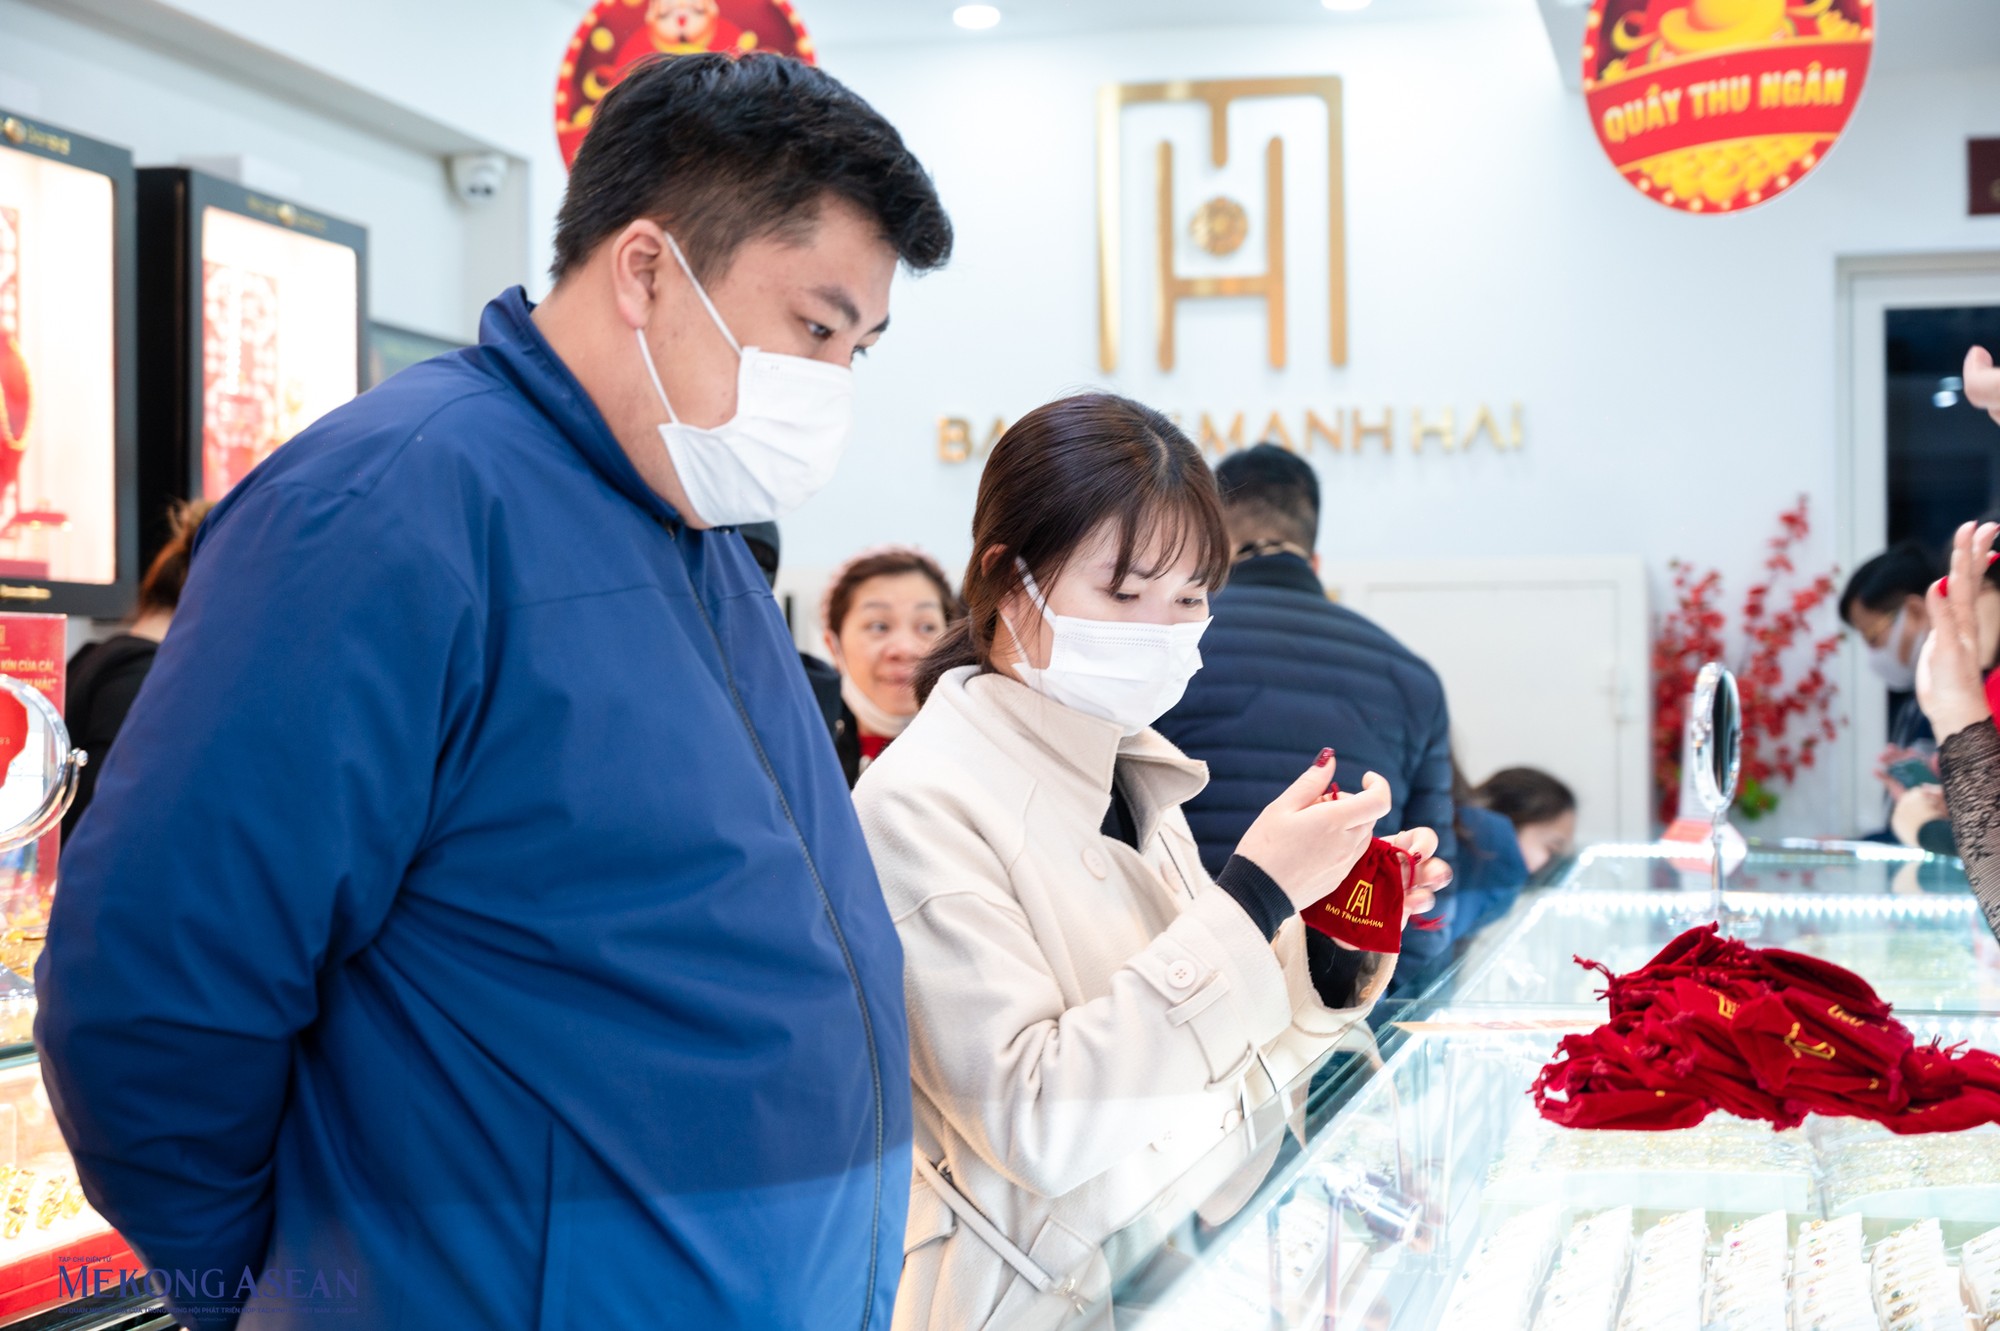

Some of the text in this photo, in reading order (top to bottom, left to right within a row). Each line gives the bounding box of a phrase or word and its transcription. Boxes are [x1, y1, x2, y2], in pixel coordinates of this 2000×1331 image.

[1688, 75, 1752, 119] THU
[1759, 61, 1848, 109] NGÂN
[1410, 400, 1524, 454] HAI
[1325, 903, 1340, 915] BAO
